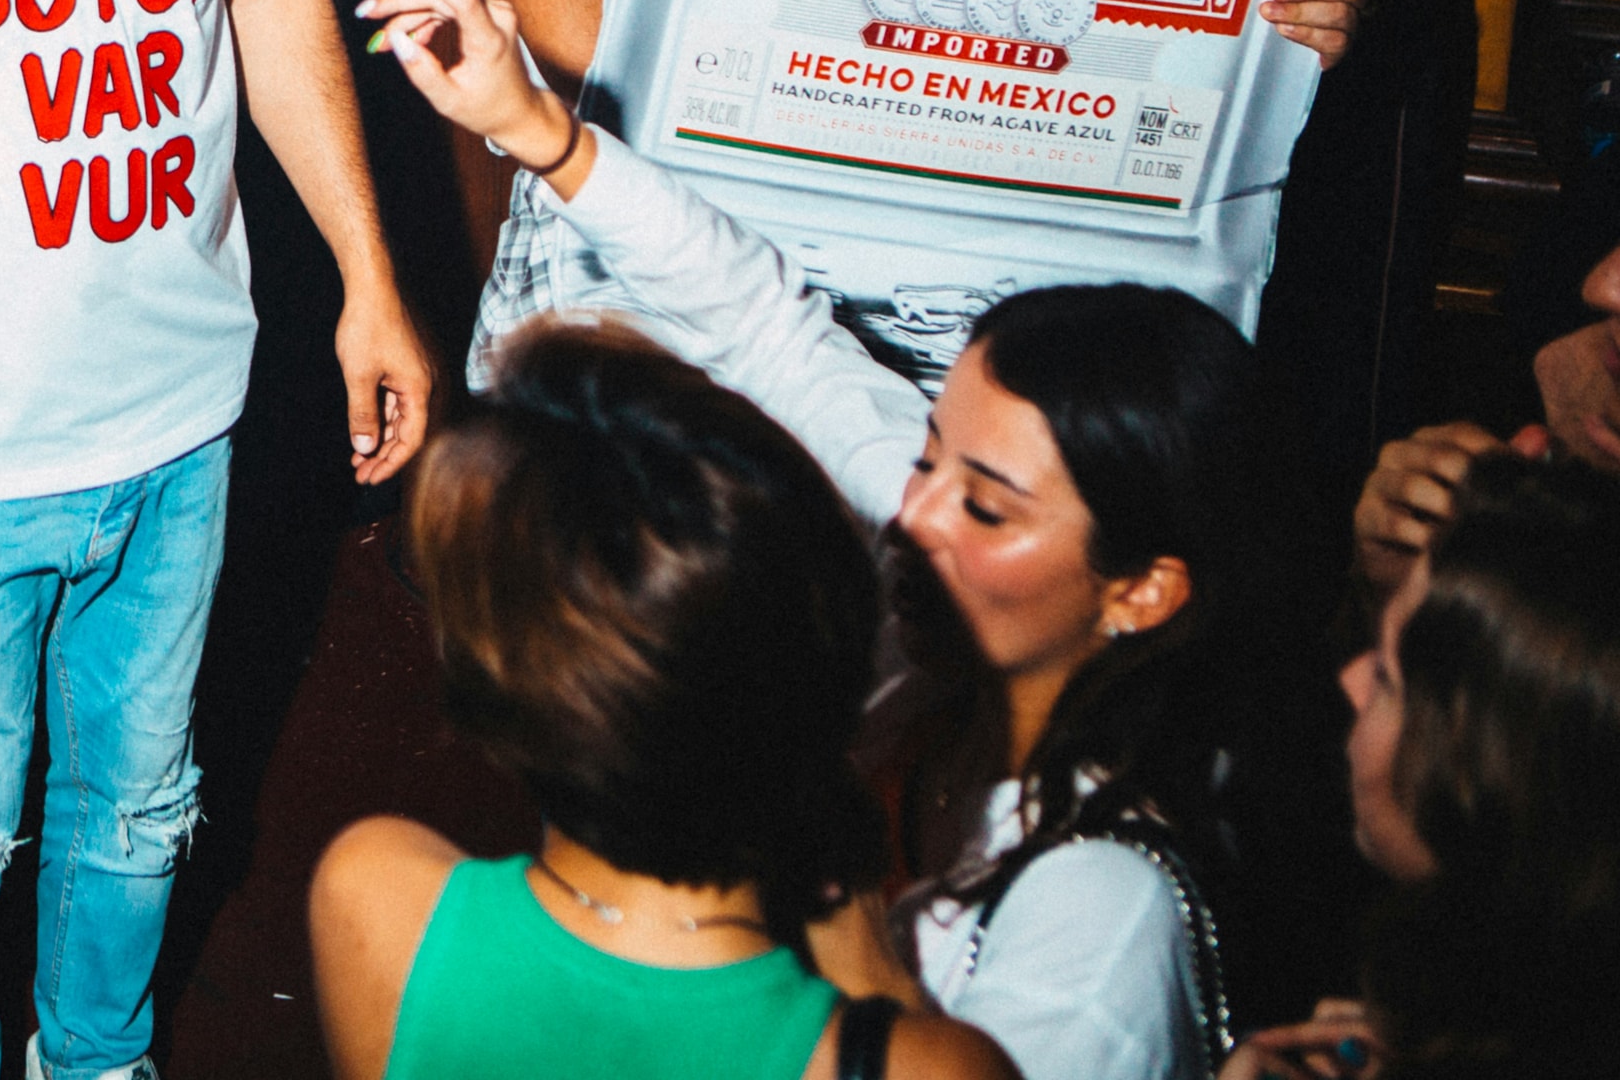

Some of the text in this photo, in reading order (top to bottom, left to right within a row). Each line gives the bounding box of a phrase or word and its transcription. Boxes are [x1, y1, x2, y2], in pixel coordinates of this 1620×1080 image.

[876, 25, 1054, 68] IMPORTED
[20, 30, 184, 143] VAR
[788, 51, 1116, 119] HECHO EN MEXICO
[772, 82, 1116, 142] HANDCRAFTED FROM AGAVE AZUL
[1139, 110, 1168, 129] NOM
[1172, 123, 1201, 138] CRT
[884, 127, 940, 144] SIERRA
[947, 137, 1004, 154] UNIDAS
[1135, 131, 1162, 146] 1451
[19, 134, 196, 250] VUR
